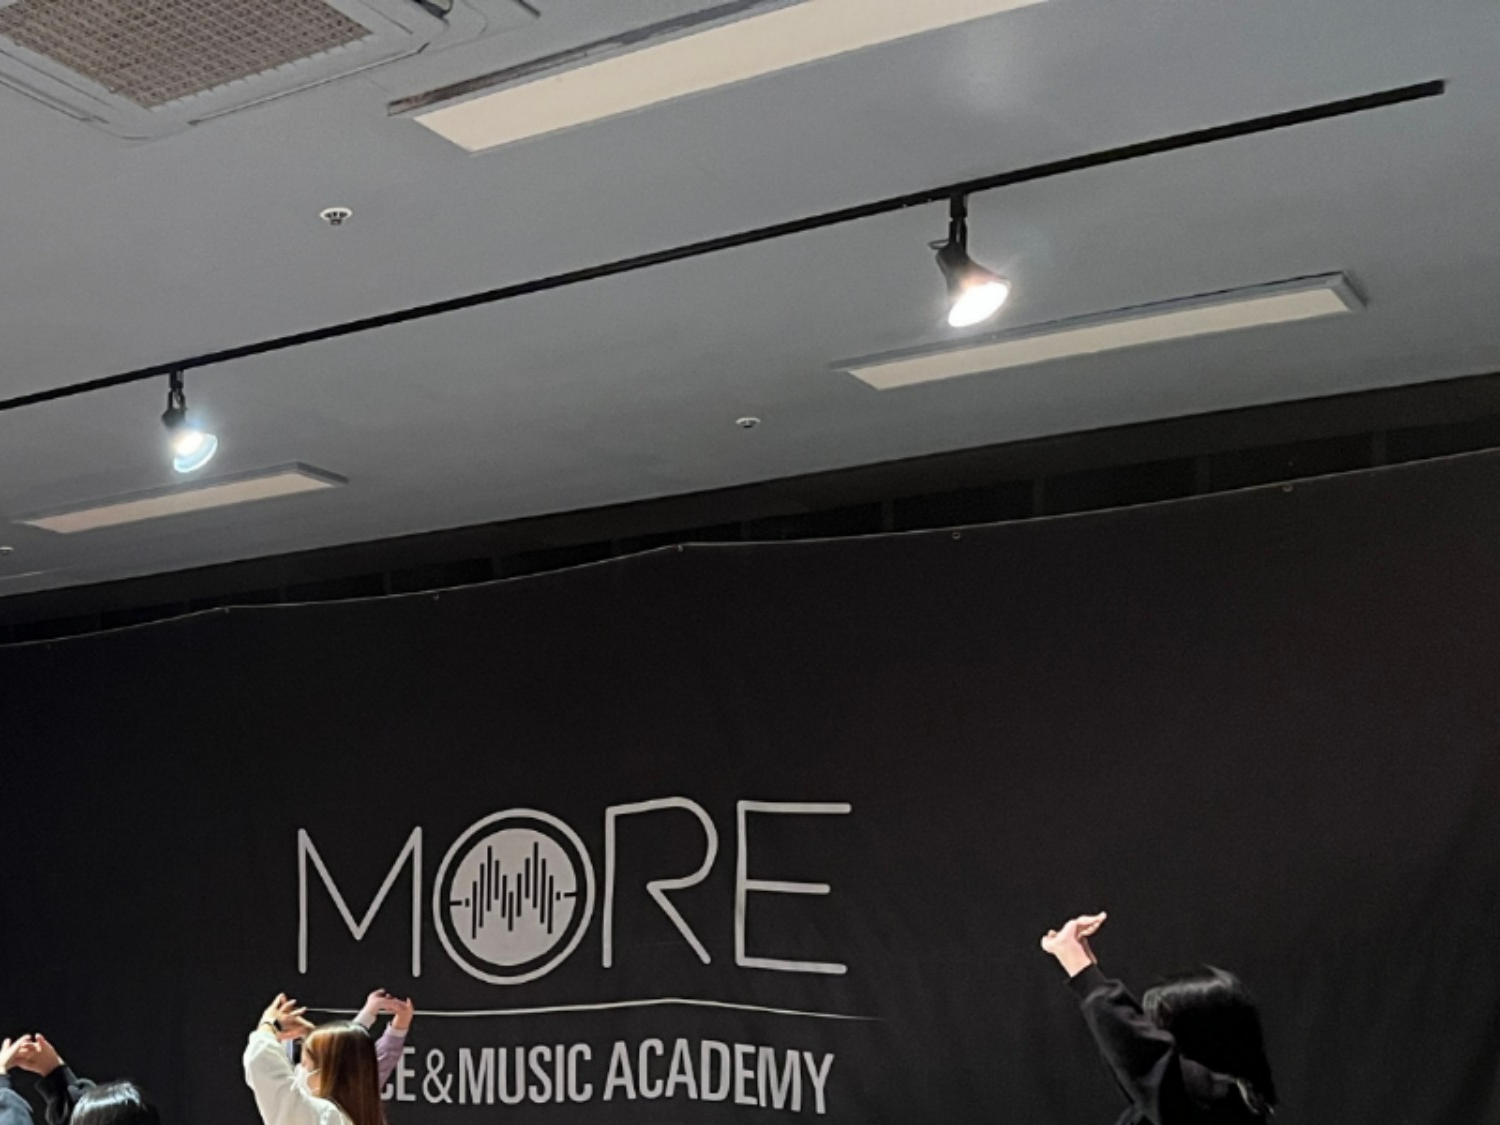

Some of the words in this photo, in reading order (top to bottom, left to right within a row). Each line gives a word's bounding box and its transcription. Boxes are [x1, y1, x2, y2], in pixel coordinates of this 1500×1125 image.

[297, 796, 852, 985] MORE
[380, 1043, 593, 1105] E&MUSIC
[602, 1037, 835, 1115] ACADEMY
